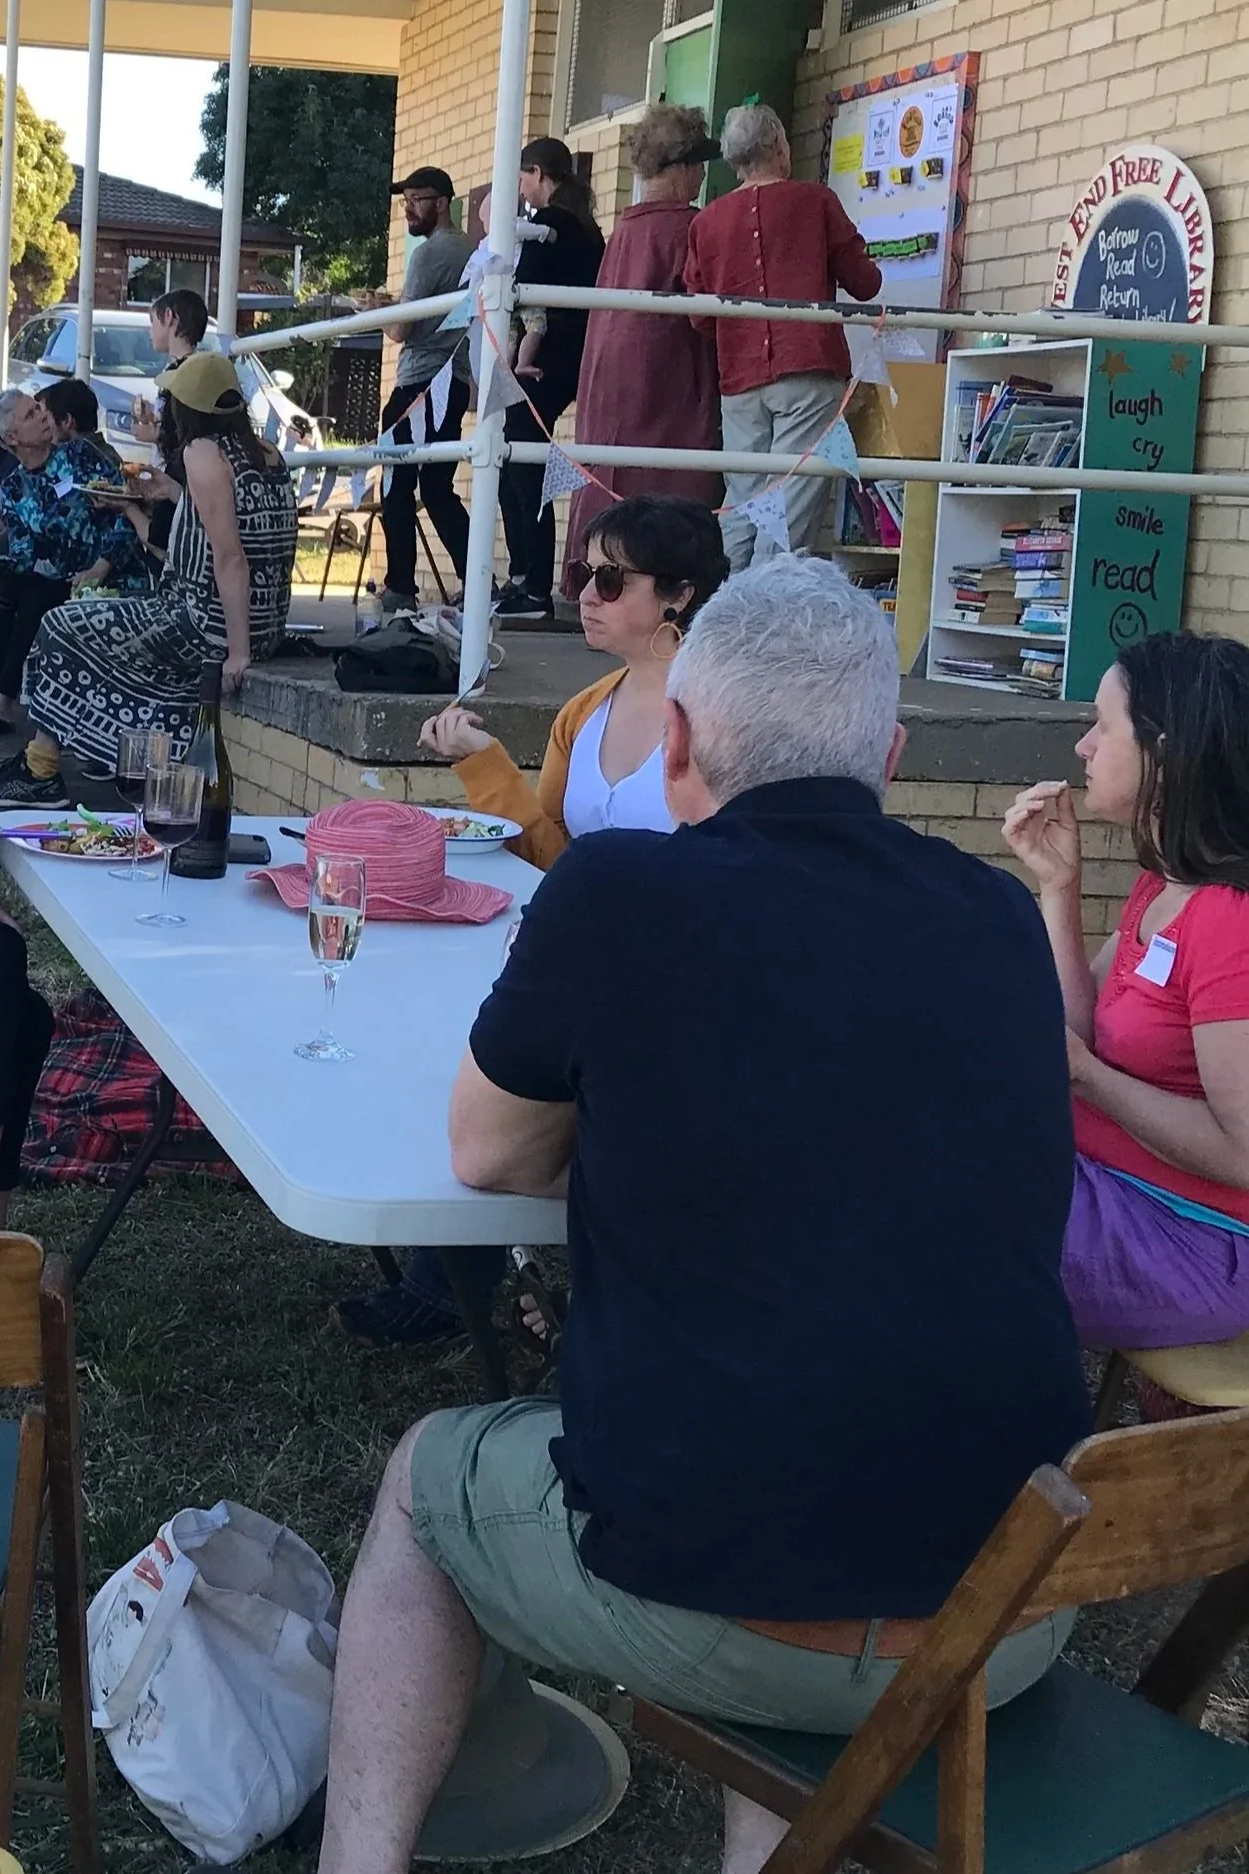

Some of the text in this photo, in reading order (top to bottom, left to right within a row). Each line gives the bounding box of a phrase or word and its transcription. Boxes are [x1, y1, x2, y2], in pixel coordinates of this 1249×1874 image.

[1051, 242, 1073, 308] EST
[1069, 175, 1107, 246] END
[1109, 154, 1163, 198] FREE
[1098, 226, 1140, 262] Borrow
[1105, 249, 1137, 281] Read
[1100, 284, 1140, 311] Return
[1109, 388, 1164, 426] laugh
[1132, 437, 1164, 472] cry
[1115, 505, 1164, 535] smile
[1092, 549, 1161, 601] read
